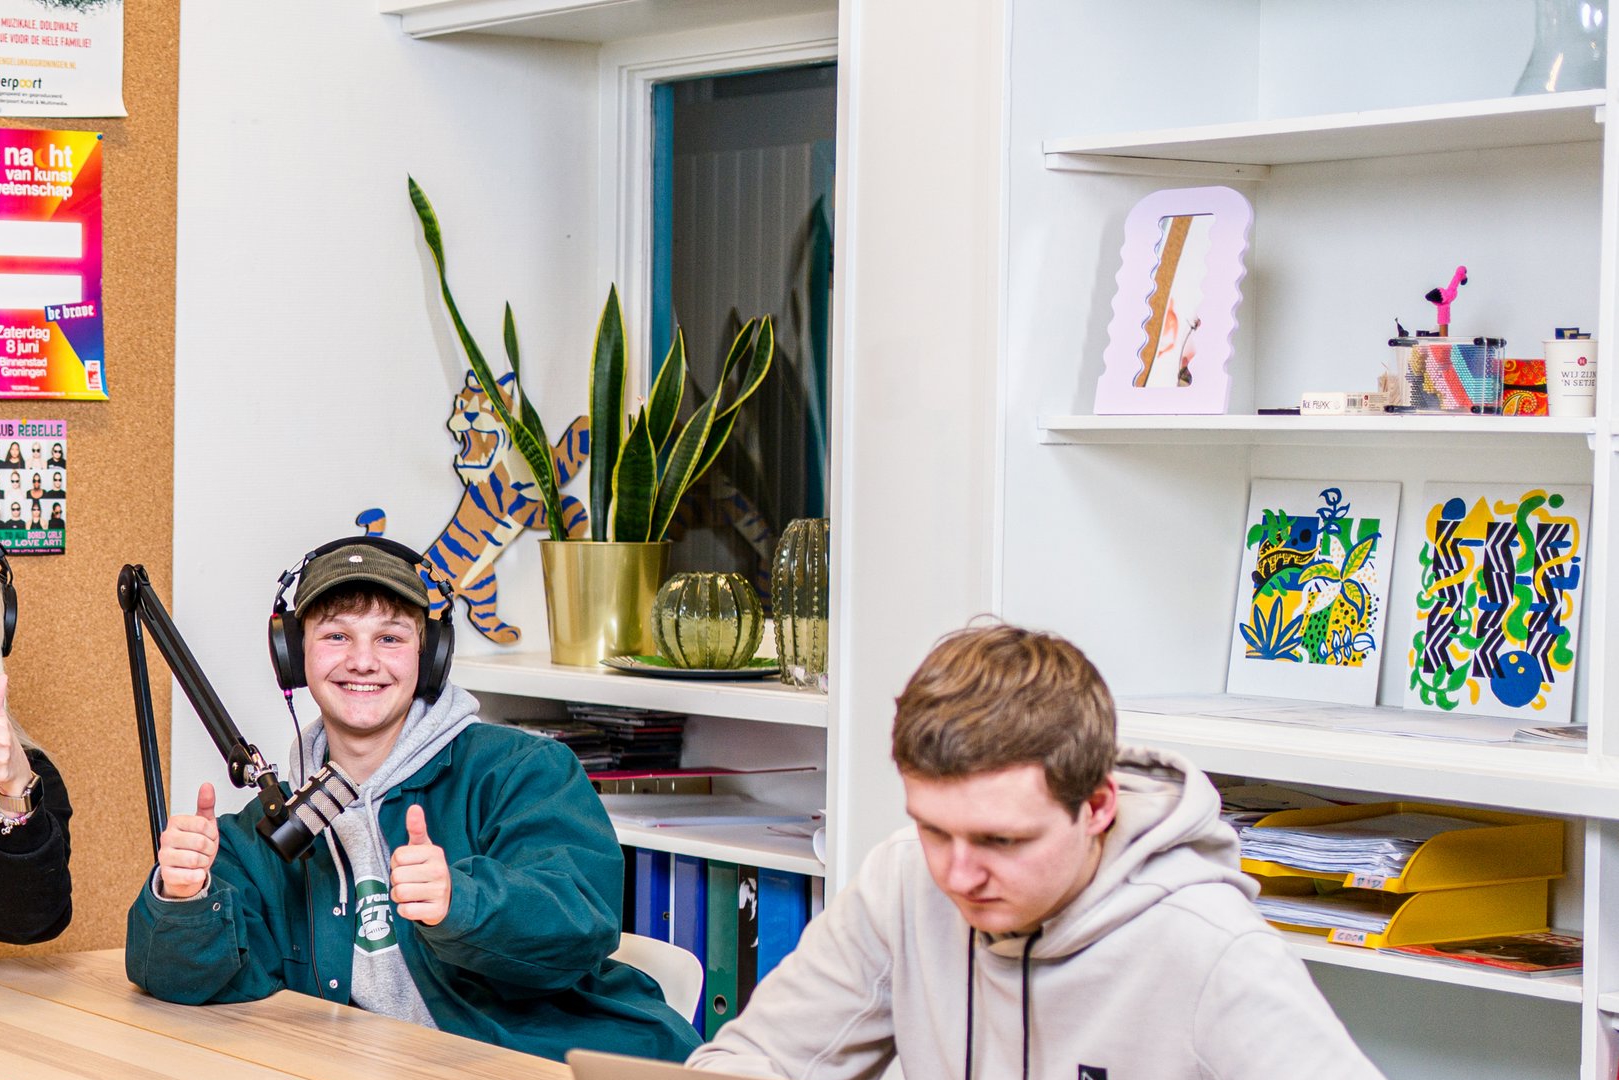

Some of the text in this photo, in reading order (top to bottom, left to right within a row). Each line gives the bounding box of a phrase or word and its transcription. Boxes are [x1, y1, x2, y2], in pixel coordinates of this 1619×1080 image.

[10, 32, 30, 45] VOOR
[31, 33, 40, 45] DE
[41, 34, 59, 46] HELE
[5, 167, 73, 182] van kunst
[47, 306, 61, 321] be
[6, 340, 39, 356] 8 juni
[0, 366, 47, 380] Groningen
[1572, 379, 1596, 387] SETJE
[18, 424, 63, 437] REBELLE
[14, 538, 63, 547] LOVE ART!
